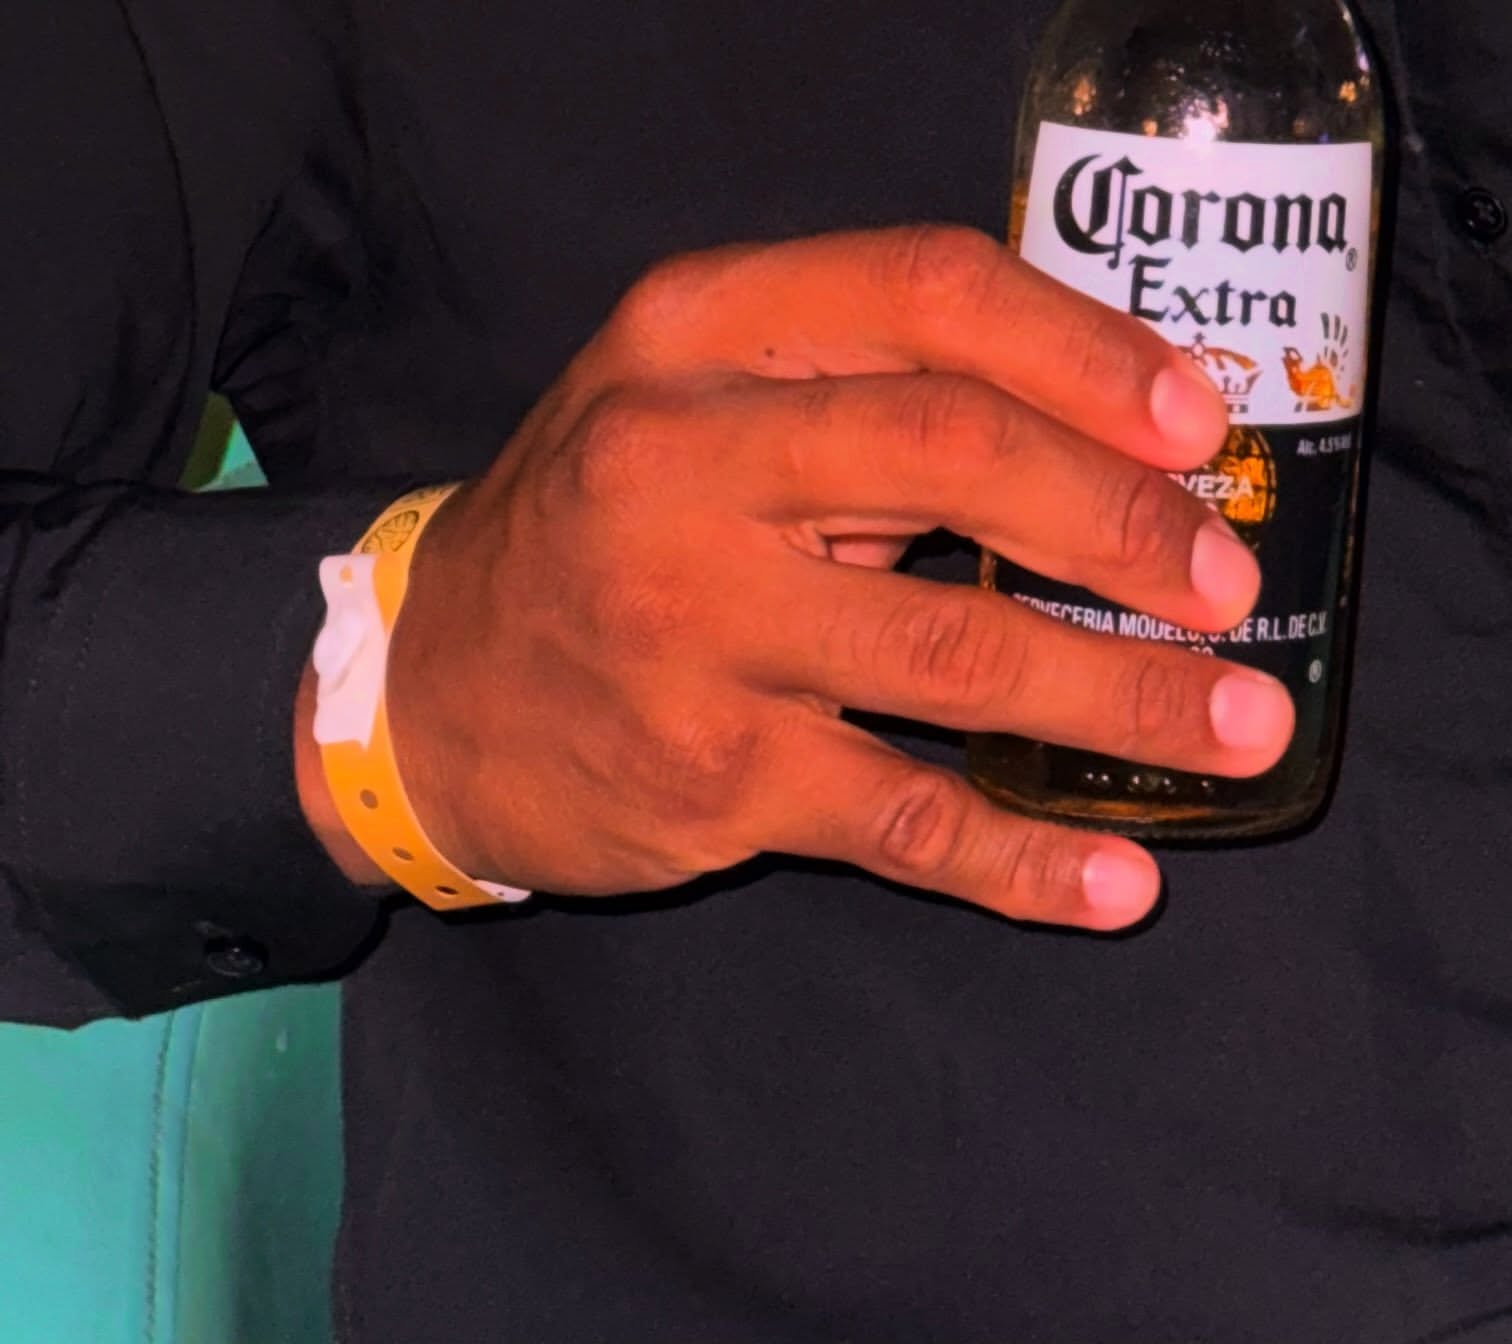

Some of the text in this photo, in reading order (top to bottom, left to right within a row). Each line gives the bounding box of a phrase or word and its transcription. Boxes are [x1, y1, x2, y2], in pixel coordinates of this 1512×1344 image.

[1053, 153, 1348, 269] Corona
[1128, 253, 1297, 328] Extra
[1167, 472, 1255, 500] VEZA
